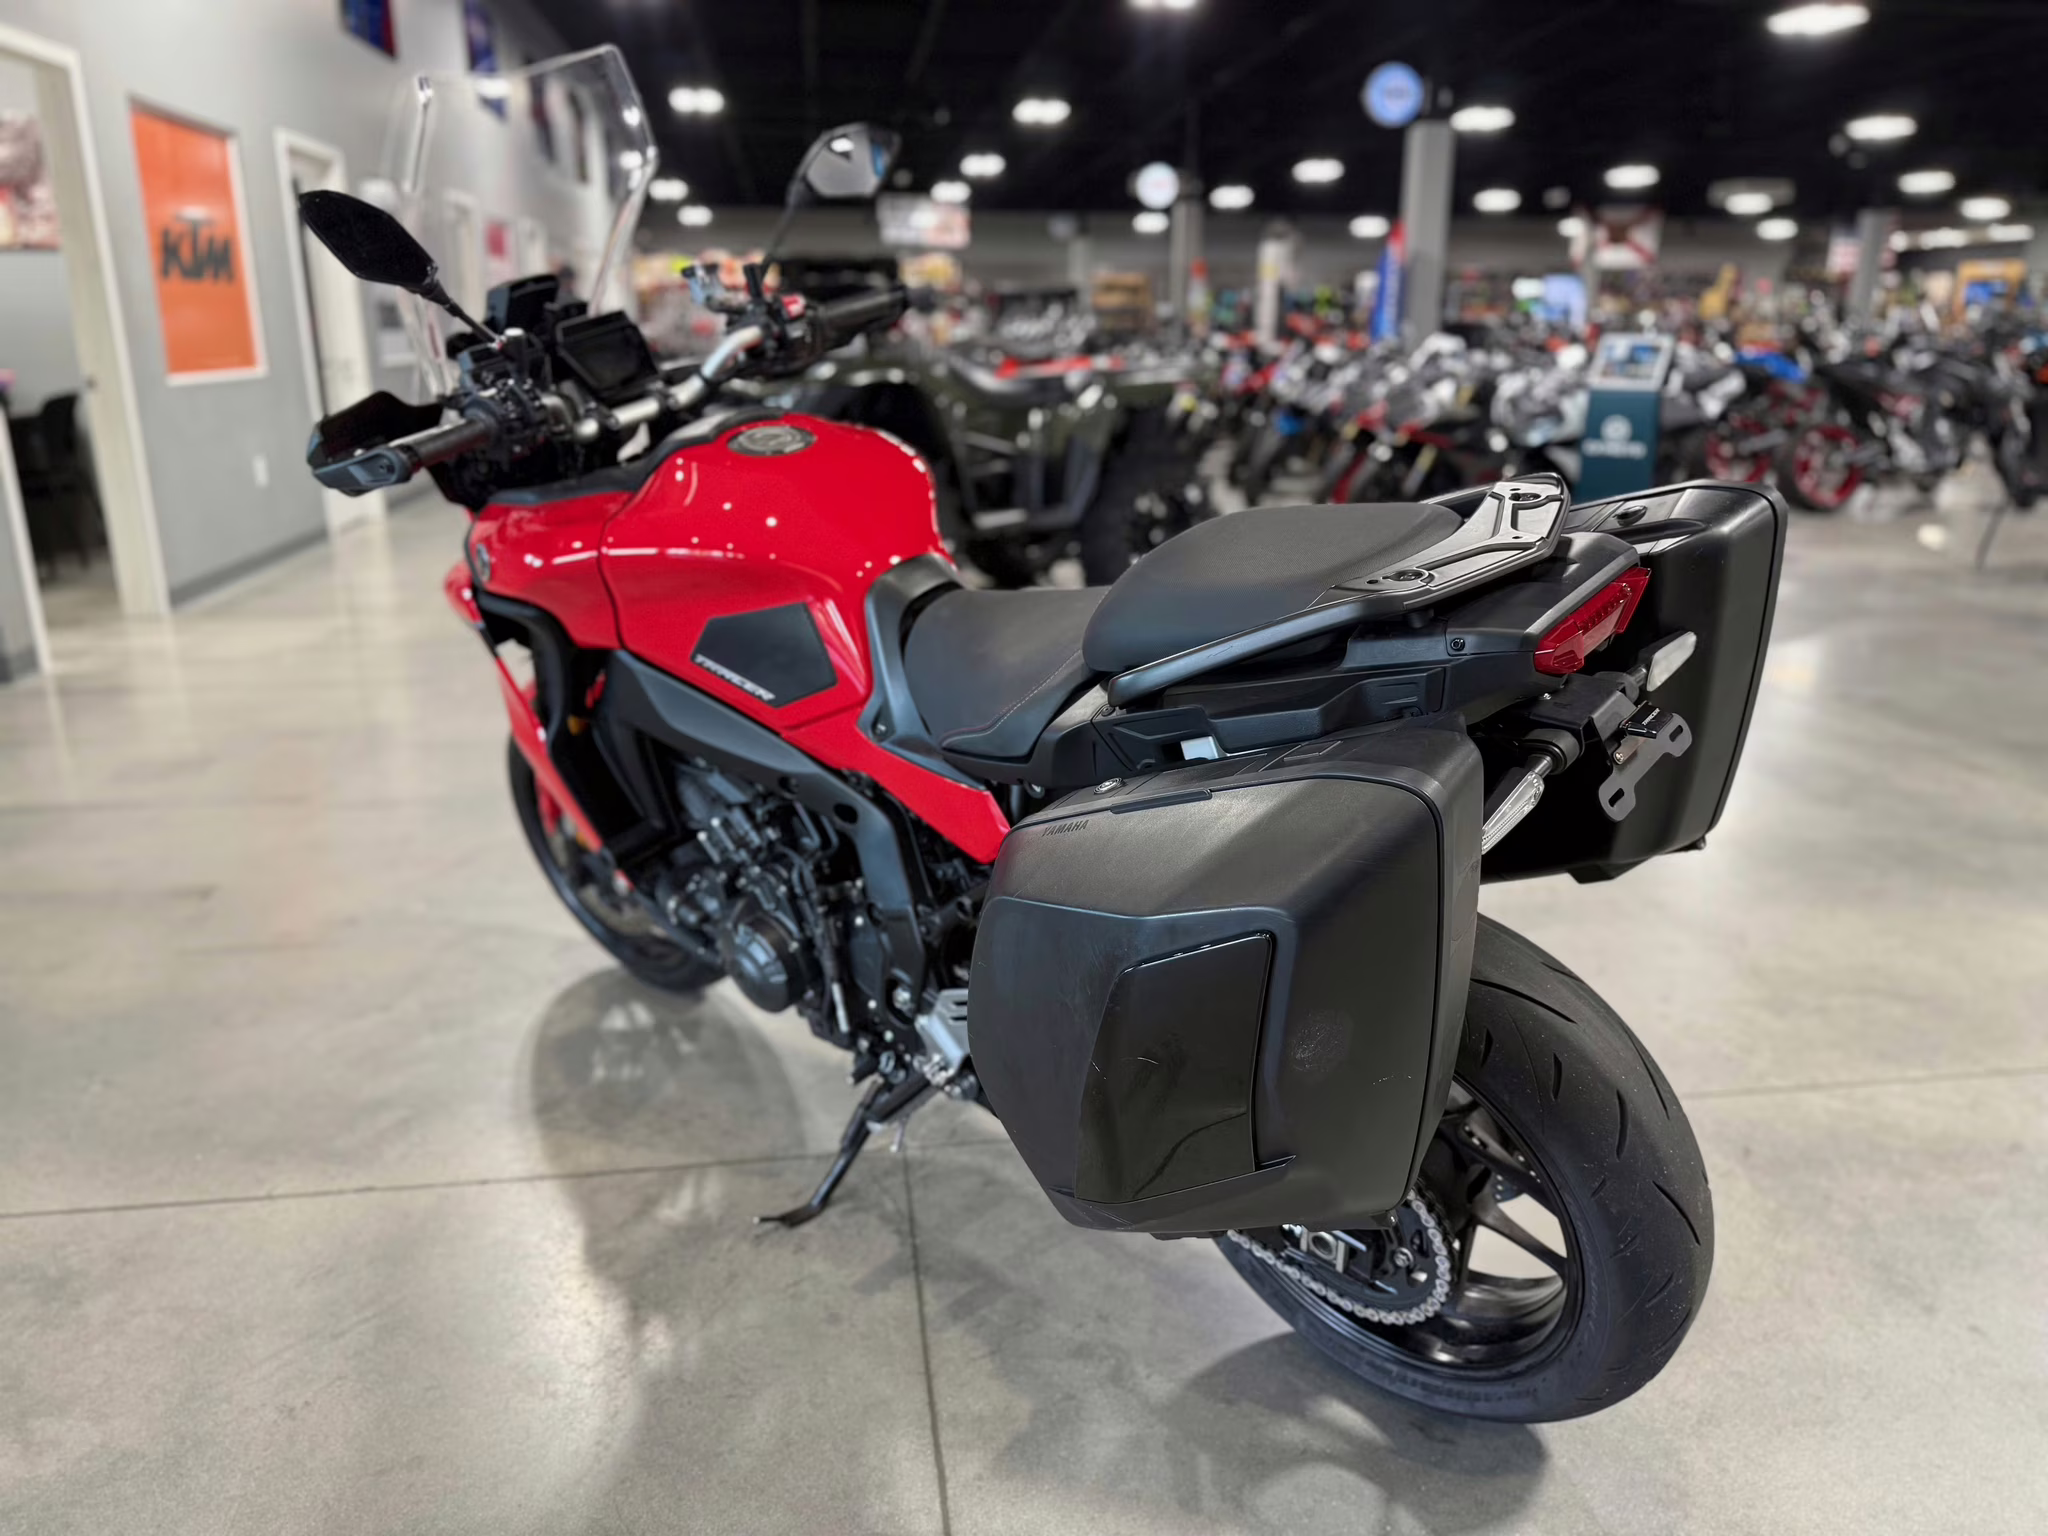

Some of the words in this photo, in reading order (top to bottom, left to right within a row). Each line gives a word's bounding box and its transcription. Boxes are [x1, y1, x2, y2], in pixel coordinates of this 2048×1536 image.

[161, 211, 235, 283] KTM
[694, 653, 776, 701] TRACER
[1041, 819, 1090, 837] YAMAHA
